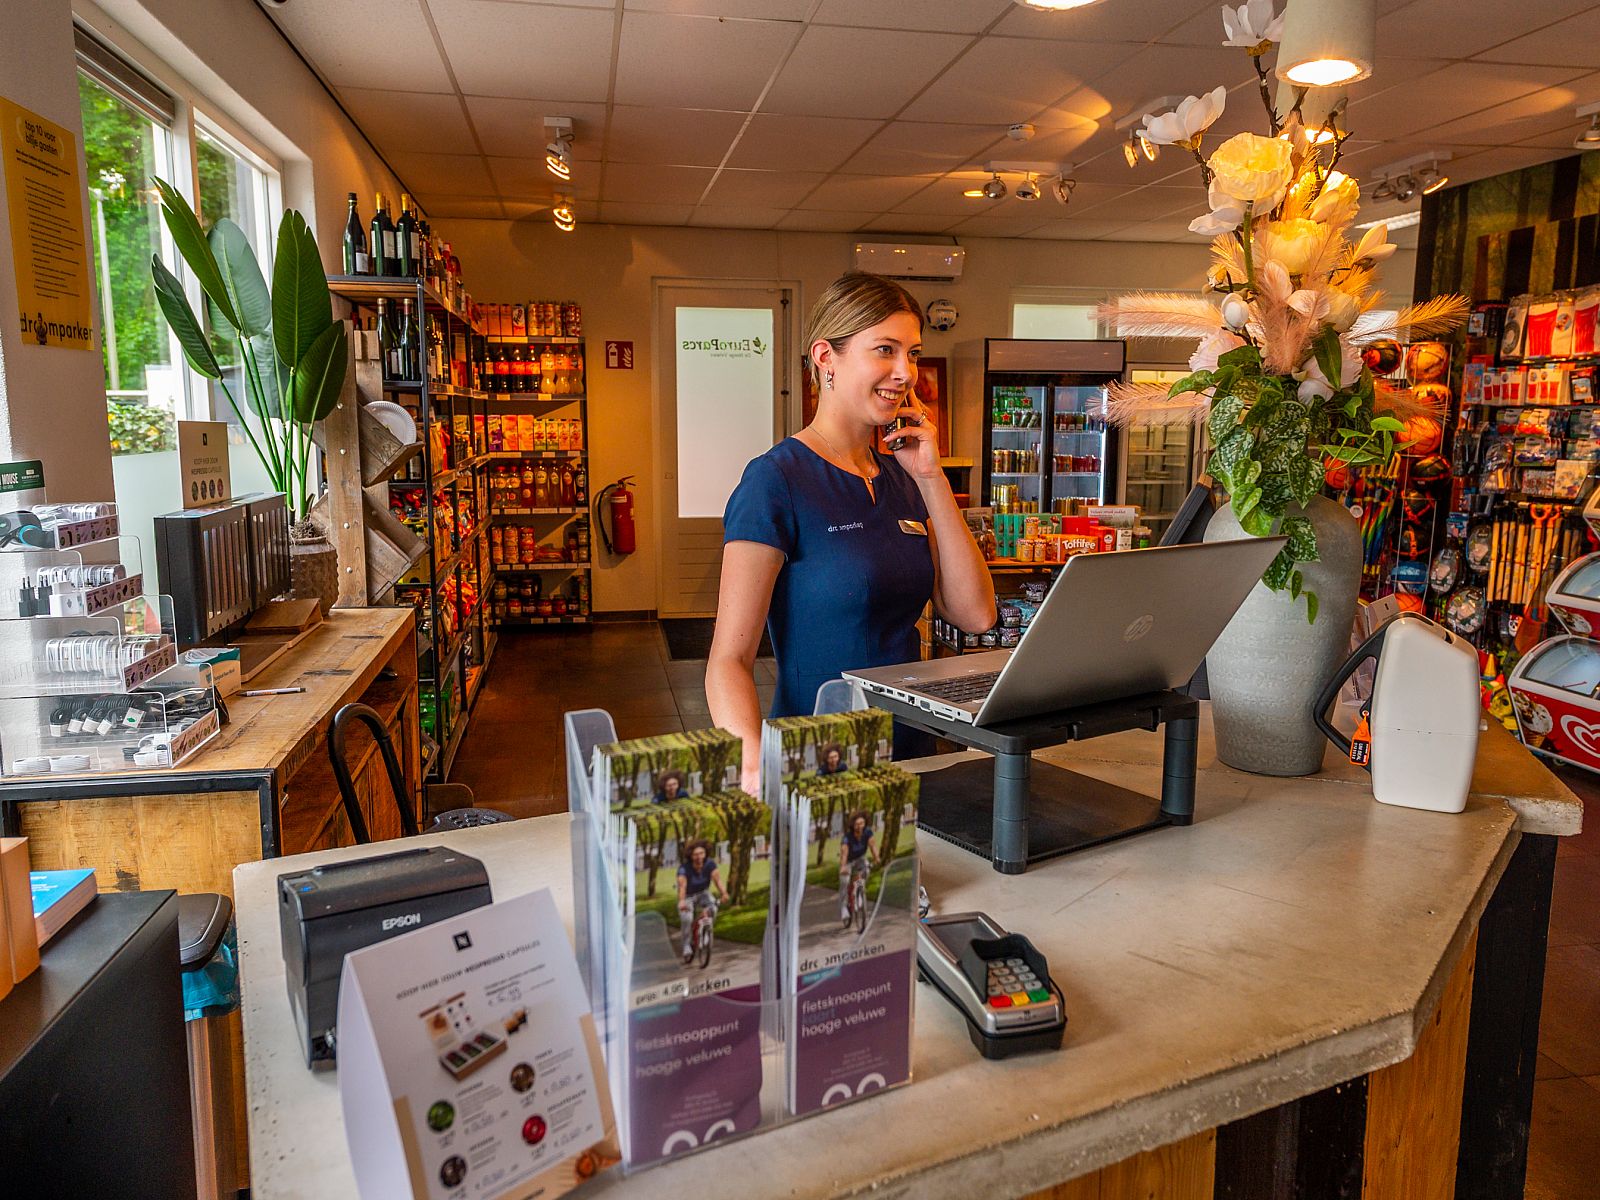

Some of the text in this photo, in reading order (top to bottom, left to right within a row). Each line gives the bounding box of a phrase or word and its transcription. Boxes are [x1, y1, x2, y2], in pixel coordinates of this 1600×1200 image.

[36, 124, 43, 137] 10
[1062, 538, 1096, 550] Toffifee
[382, 912, 421, 931] EPSON
[802, 981, 892, 1015] fietsknooppunt
[636, 1019, 739, 1051] fietsknooppunt
[801, 1006, 887, 1039] hooge veluwe
[635, 1058, 682, 1079] hooge
[685, 1043, 732, 1067] veluwe
